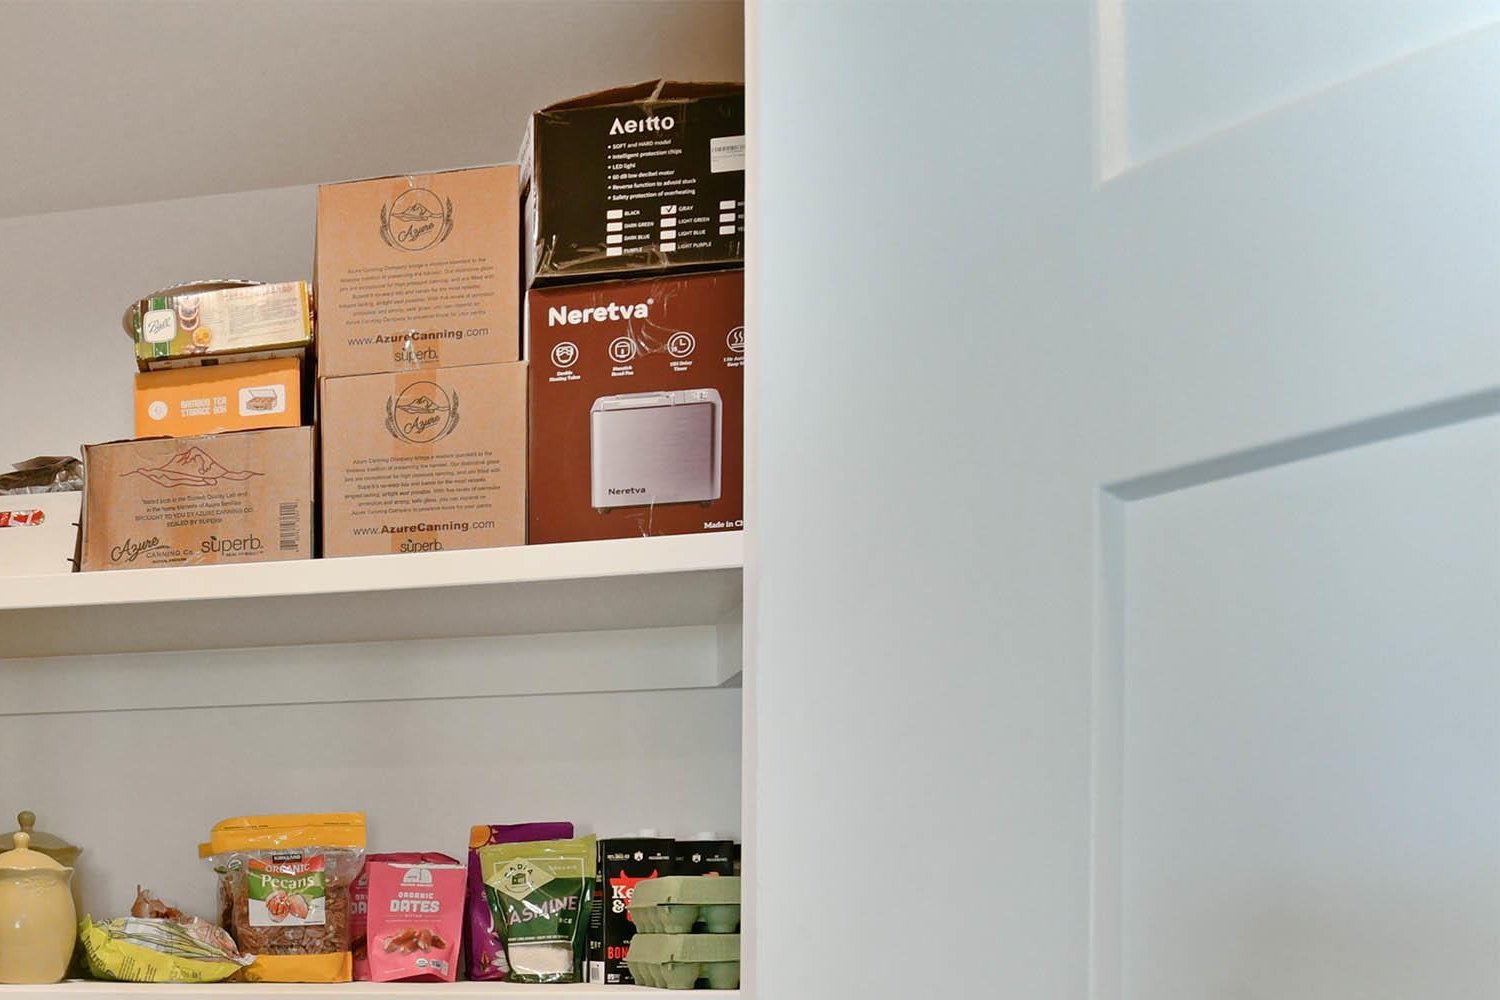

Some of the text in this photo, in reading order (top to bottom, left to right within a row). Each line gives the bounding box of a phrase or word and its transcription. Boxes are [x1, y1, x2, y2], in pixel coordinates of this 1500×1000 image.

[609, 116, 675, 135] Aeitto
[548, 302, 650, 326] Neretva
[404, 414, 440, 435] Azure
[608, 486, 646, 496] Neretva
[353, 519, 495, 537] www.AzureCanning.com
[704, 521, 725, 529] Made
[110, 536, 161, 563] Azure
[261, 874, 315, 890] Pecans
[390, 900, 440, 912] DATES
[506, 896, 578, 926] ASMINE
[607, 946, 630, 960] BON
